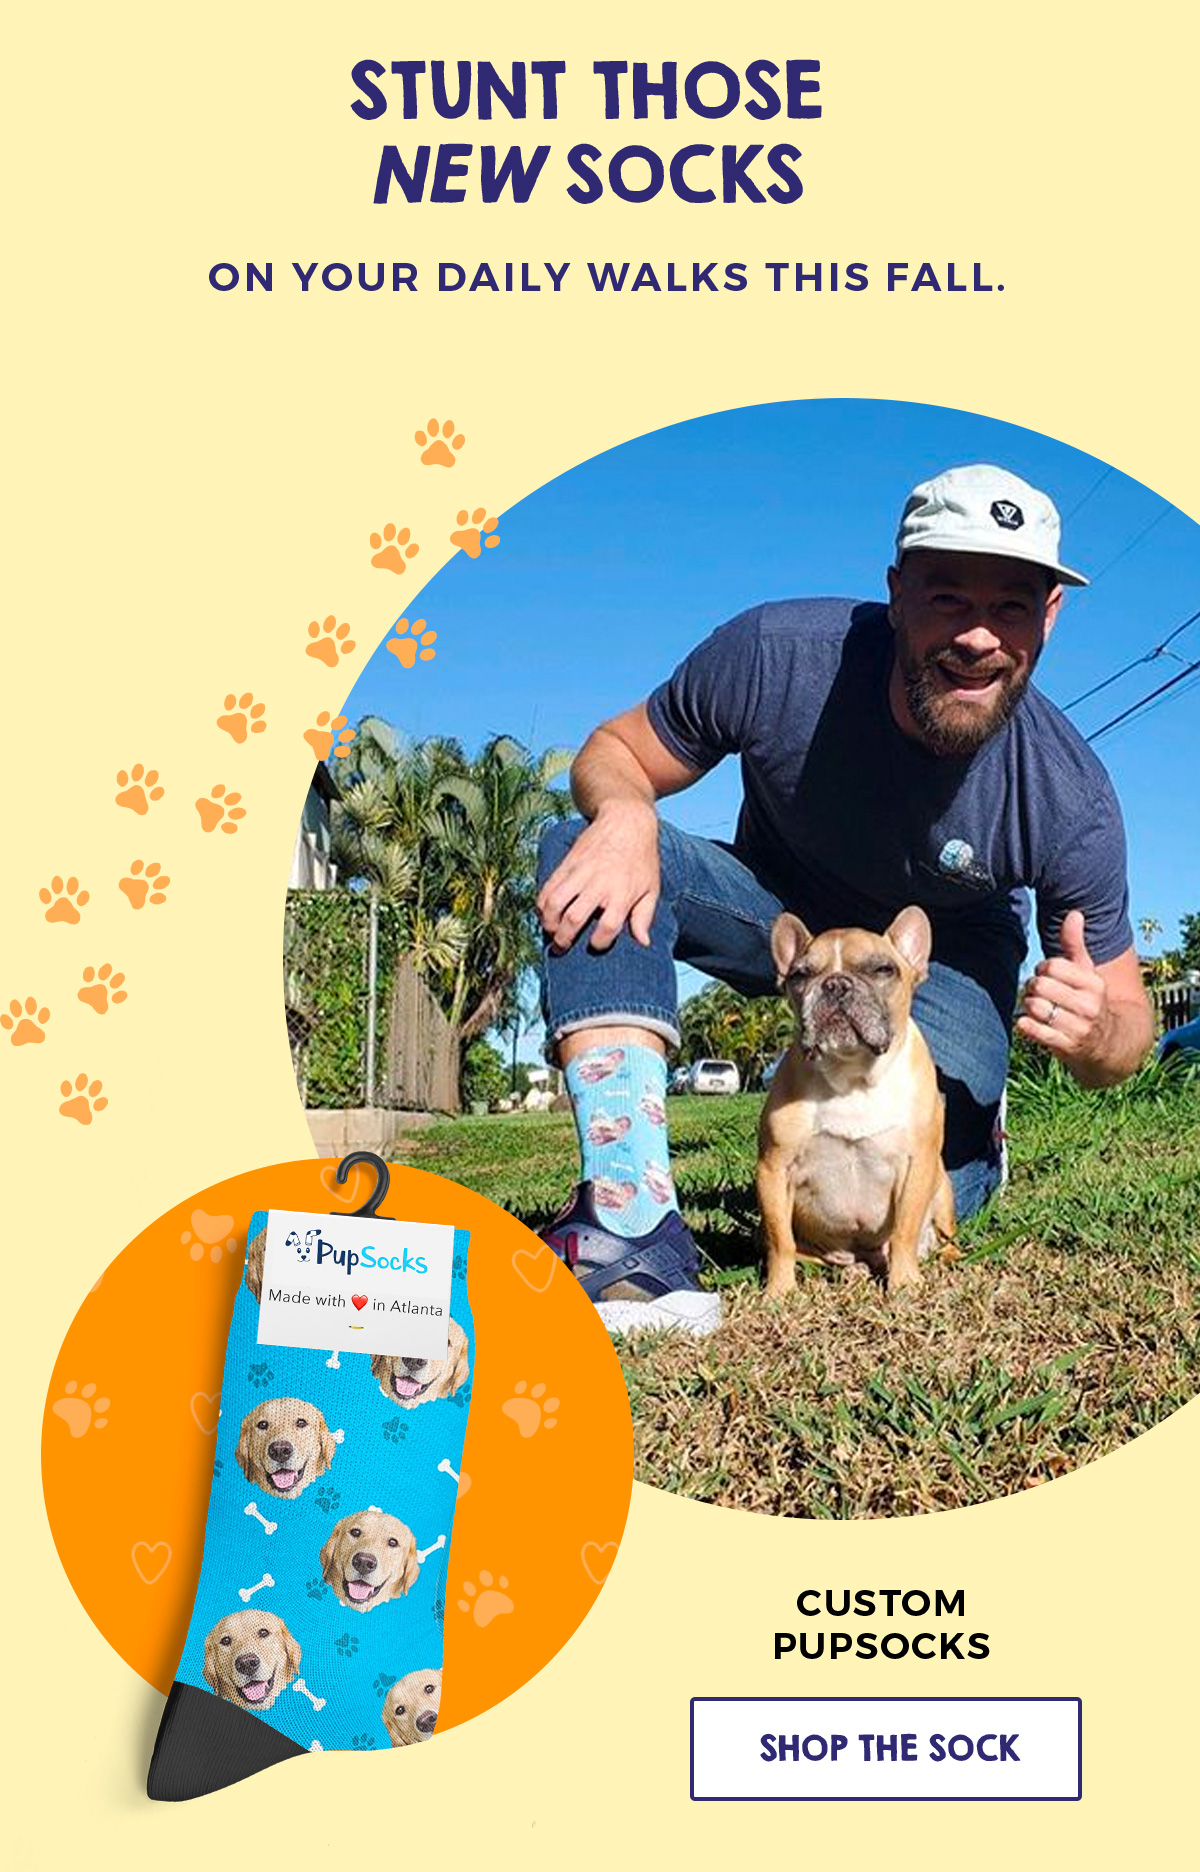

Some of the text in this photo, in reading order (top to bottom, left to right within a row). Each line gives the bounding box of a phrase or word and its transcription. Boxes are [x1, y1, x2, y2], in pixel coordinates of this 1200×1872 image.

[316, 1239, 428, 1275] PupSocks
[268, 1288, 443, 1317] Made with in Atlanta
